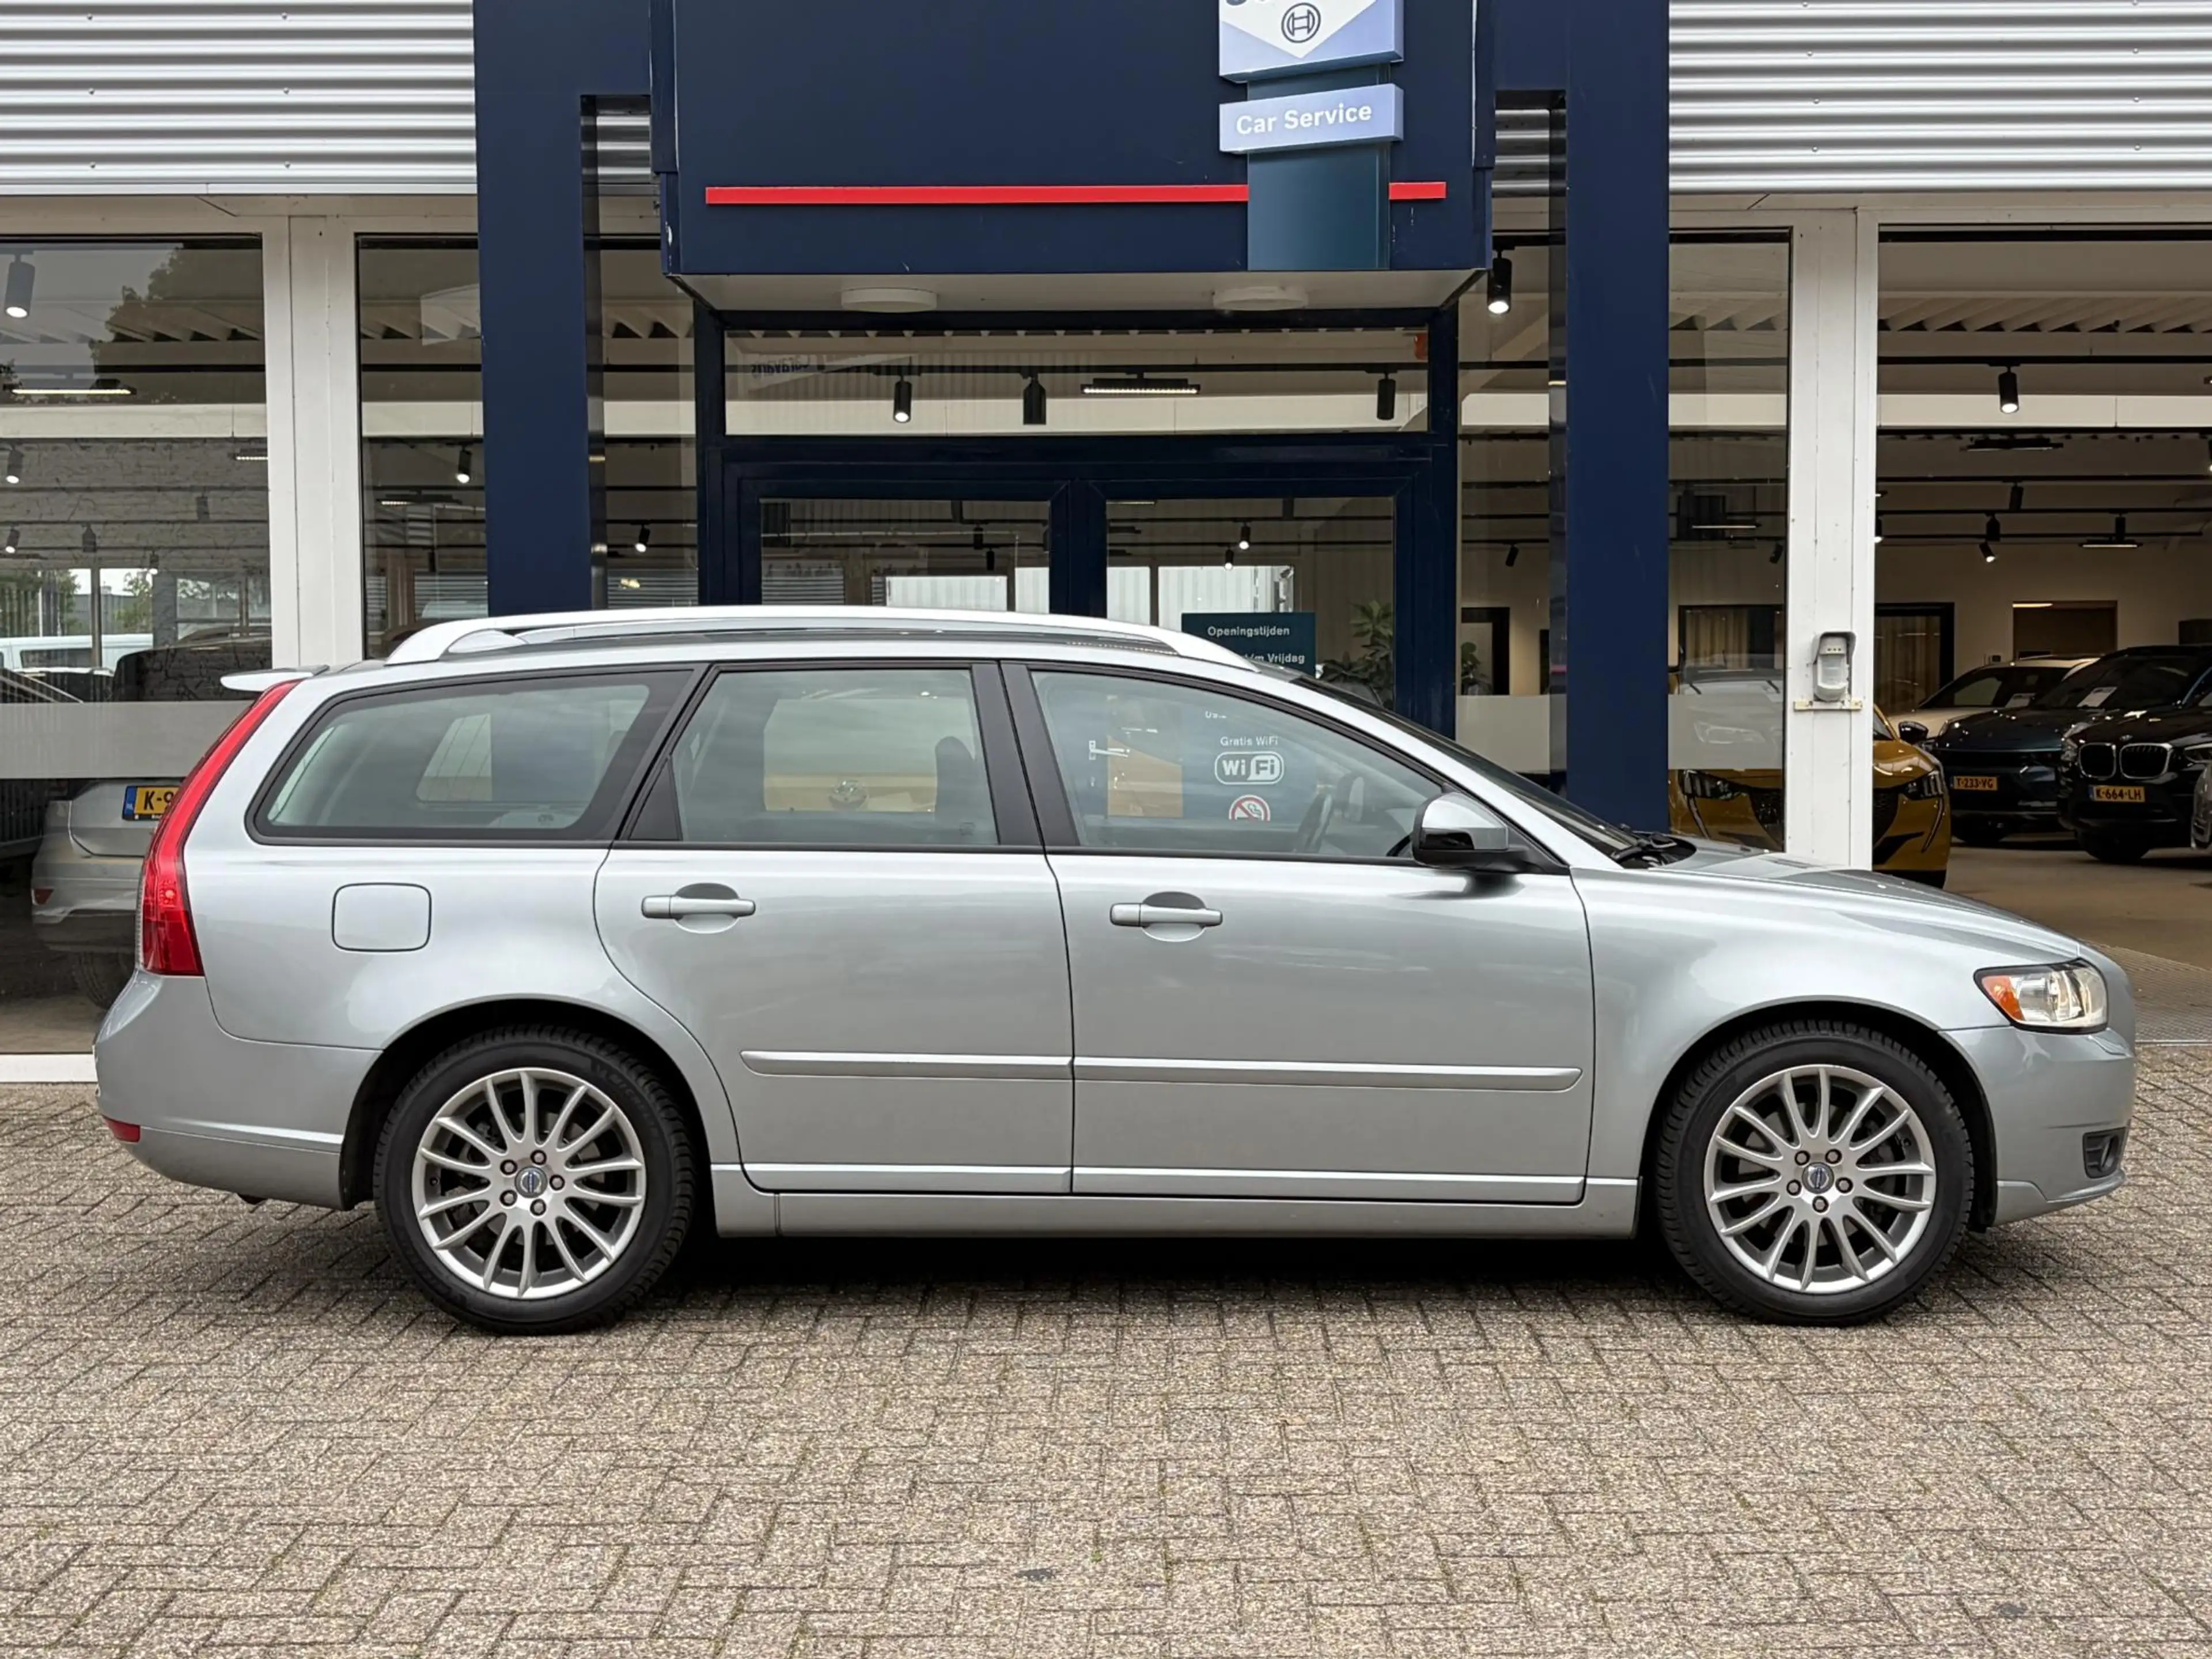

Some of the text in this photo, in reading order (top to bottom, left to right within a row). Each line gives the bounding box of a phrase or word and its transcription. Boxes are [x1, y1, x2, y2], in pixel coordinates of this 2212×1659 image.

[1236, 103, 1372, 135] Car Service
[1207, 626, 1290, 638] Openingstijden
[1267, 653, 1305, 664] Vrijdag
[1220, 735, 1278, 747] Gratis WiFi
[2096, 787, 2142, 800] K-664-LH
